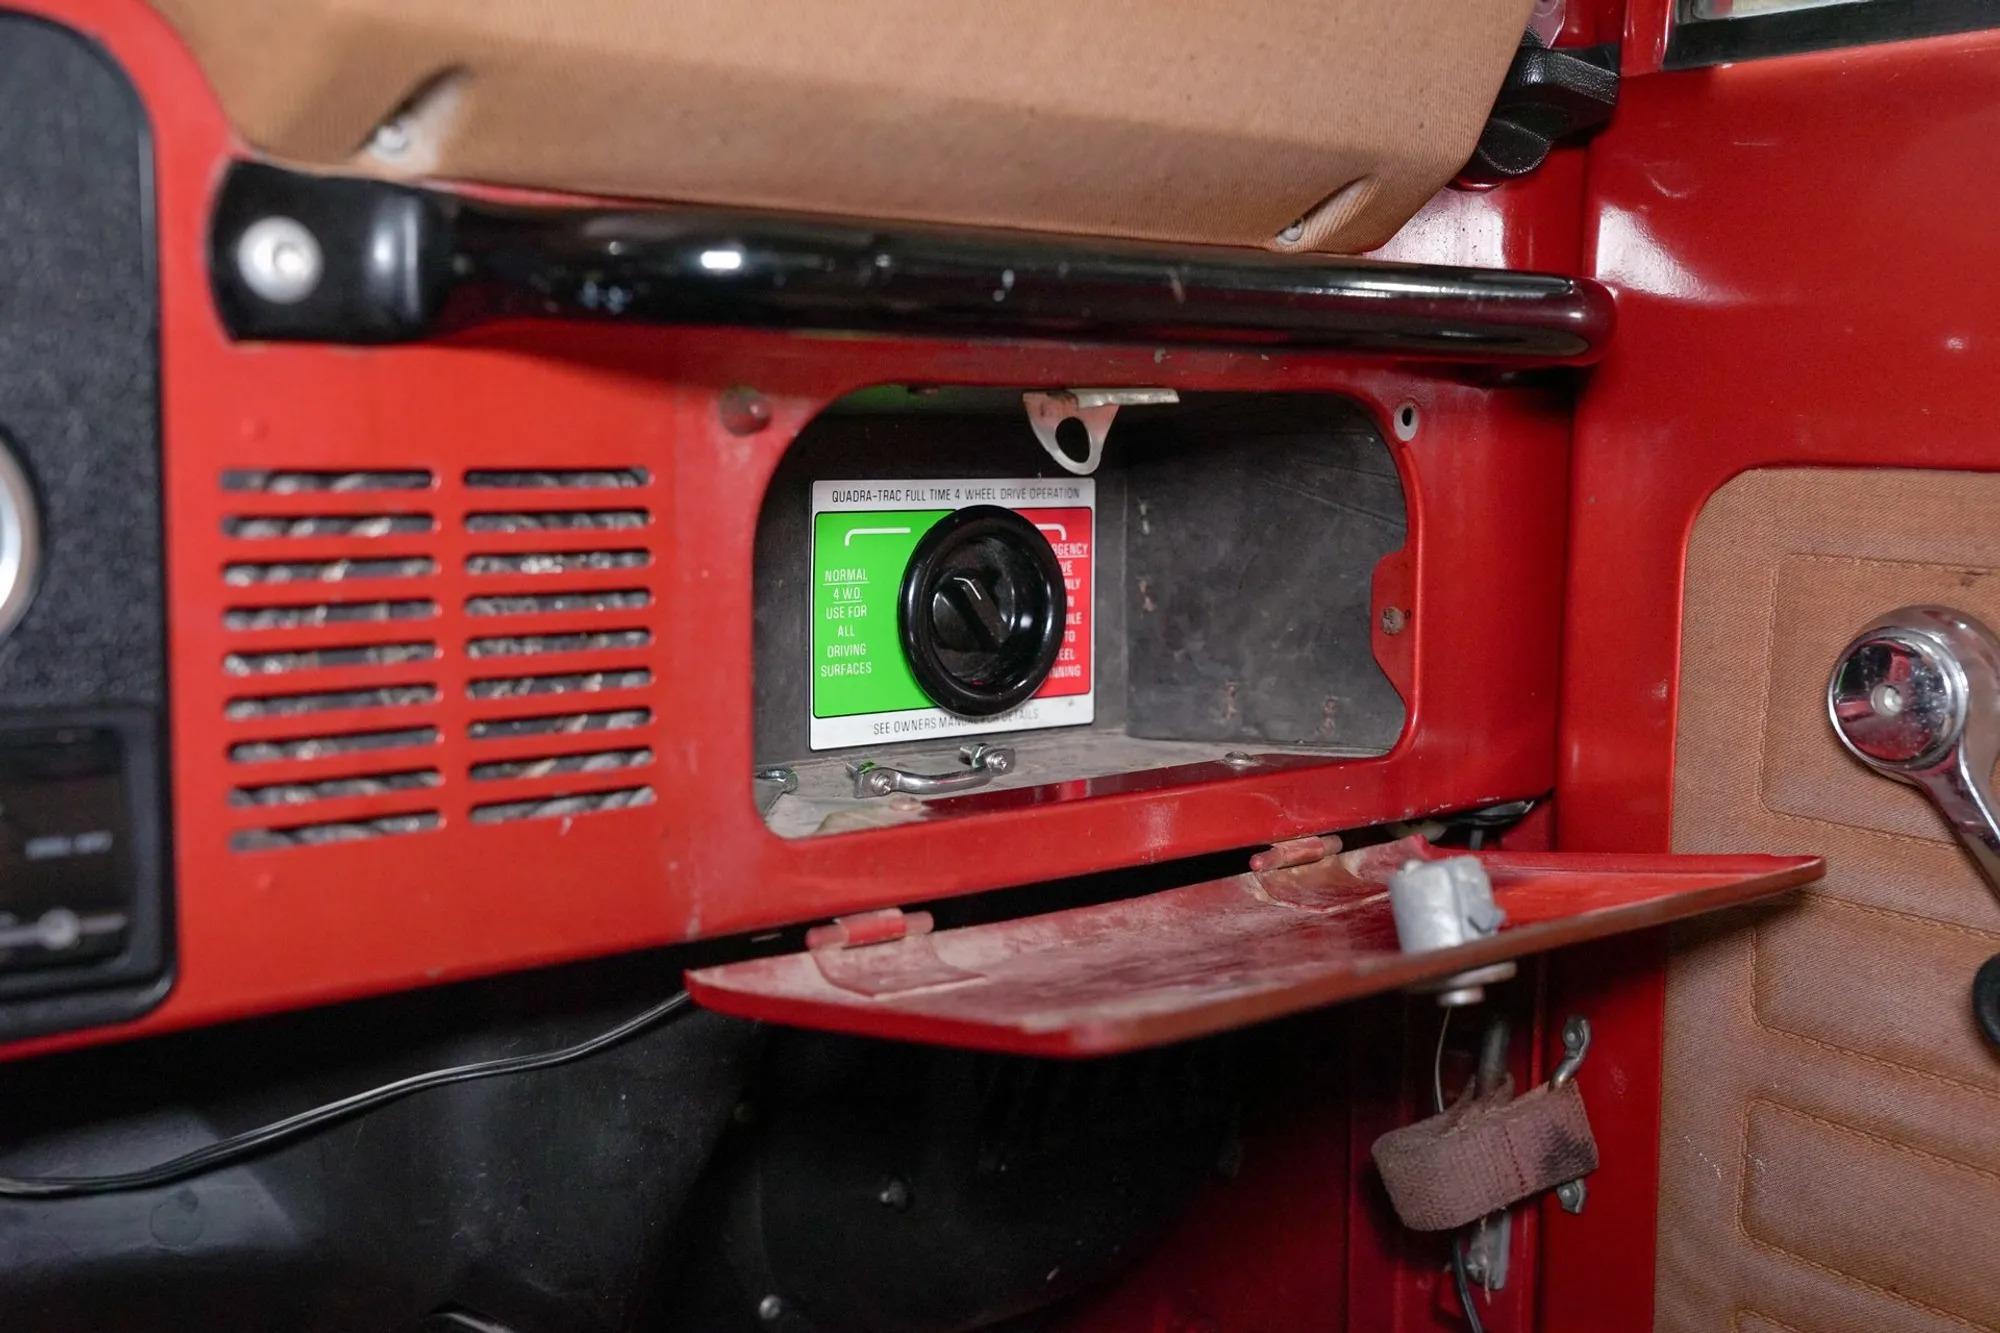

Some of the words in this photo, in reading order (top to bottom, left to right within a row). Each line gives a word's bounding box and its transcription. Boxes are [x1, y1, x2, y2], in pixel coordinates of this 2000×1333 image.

[832, 489, 902, 503] QUADRA-TRAC
[905, 489, 926, 502] FULL
[930, 488, 951, 501] TIME
[954, 488, 961, 501] 4
[965, 487, 996, 500] WHEEL
[1000, 487, 1027, 500] DRIVE
[1029, 486, 1081, 499] OPERATION
[1051, 542, 1088, 556] RGENCY
[824, 568, 869, 582] NORMAL
[1064, 577, 1081, 591] NLY
[833, 587, 840, 600] 4
[825, 605, 845, 620] USE
[848, 604, 867, 618] FOR
[837, 624, 855, 637] ALL
[826, 643, 867, 658] DRIVING
[820, 661, 873, 678] SURFACES
[873, 722, 890, 735] SEE
[893, 717, 936, 733] OWNERS
